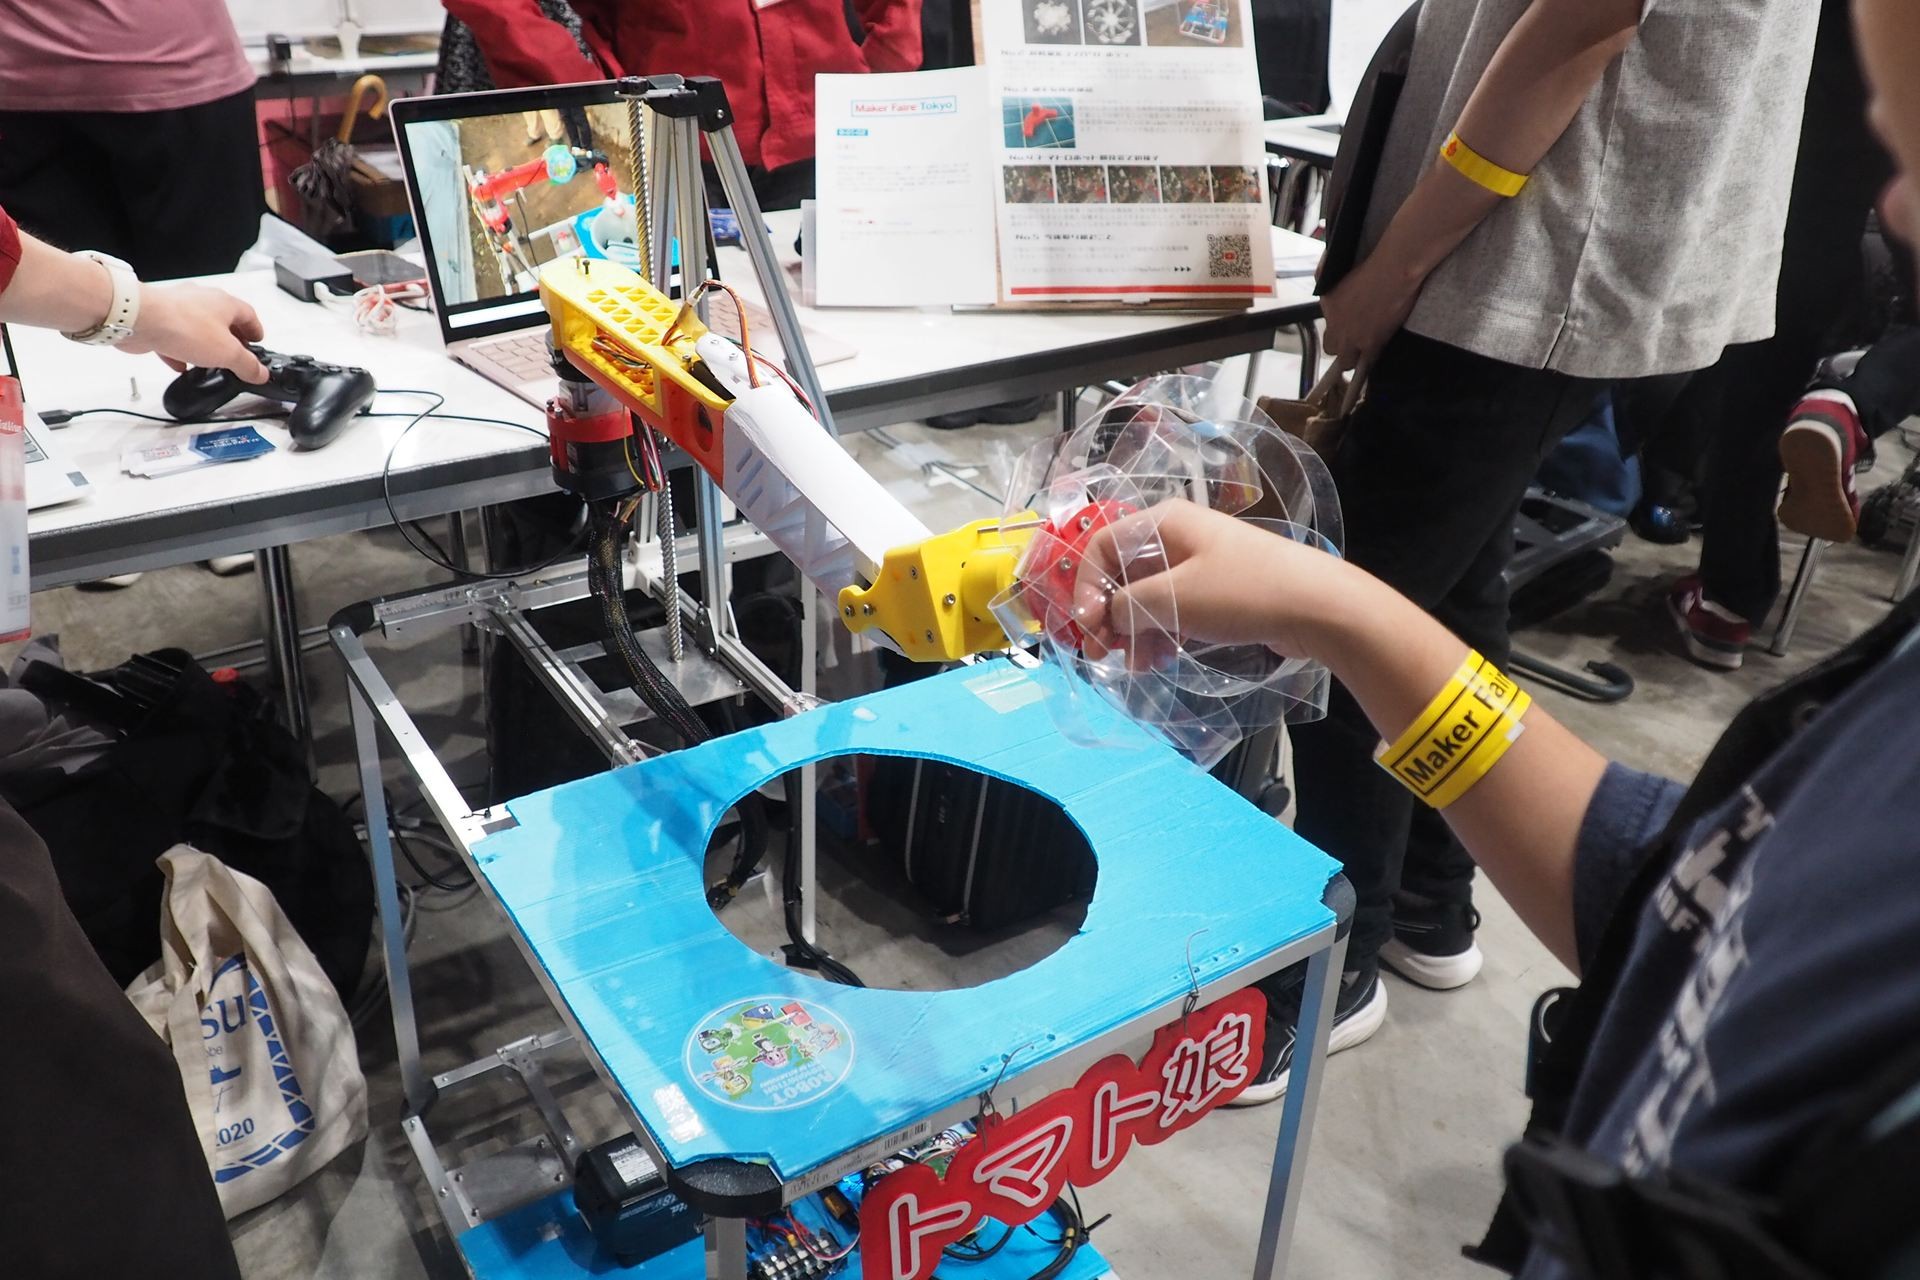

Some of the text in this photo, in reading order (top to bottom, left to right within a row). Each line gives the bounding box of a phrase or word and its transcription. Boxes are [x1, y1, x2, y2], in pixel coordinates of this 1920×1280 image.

[855, 101, 953, 113] Maker Faire Tokyo
[1403, 709, 1480, 786] Maker
[216, 1117, 255, 1147] 020
[888, 1012, 1252, 1280] トマト娘
